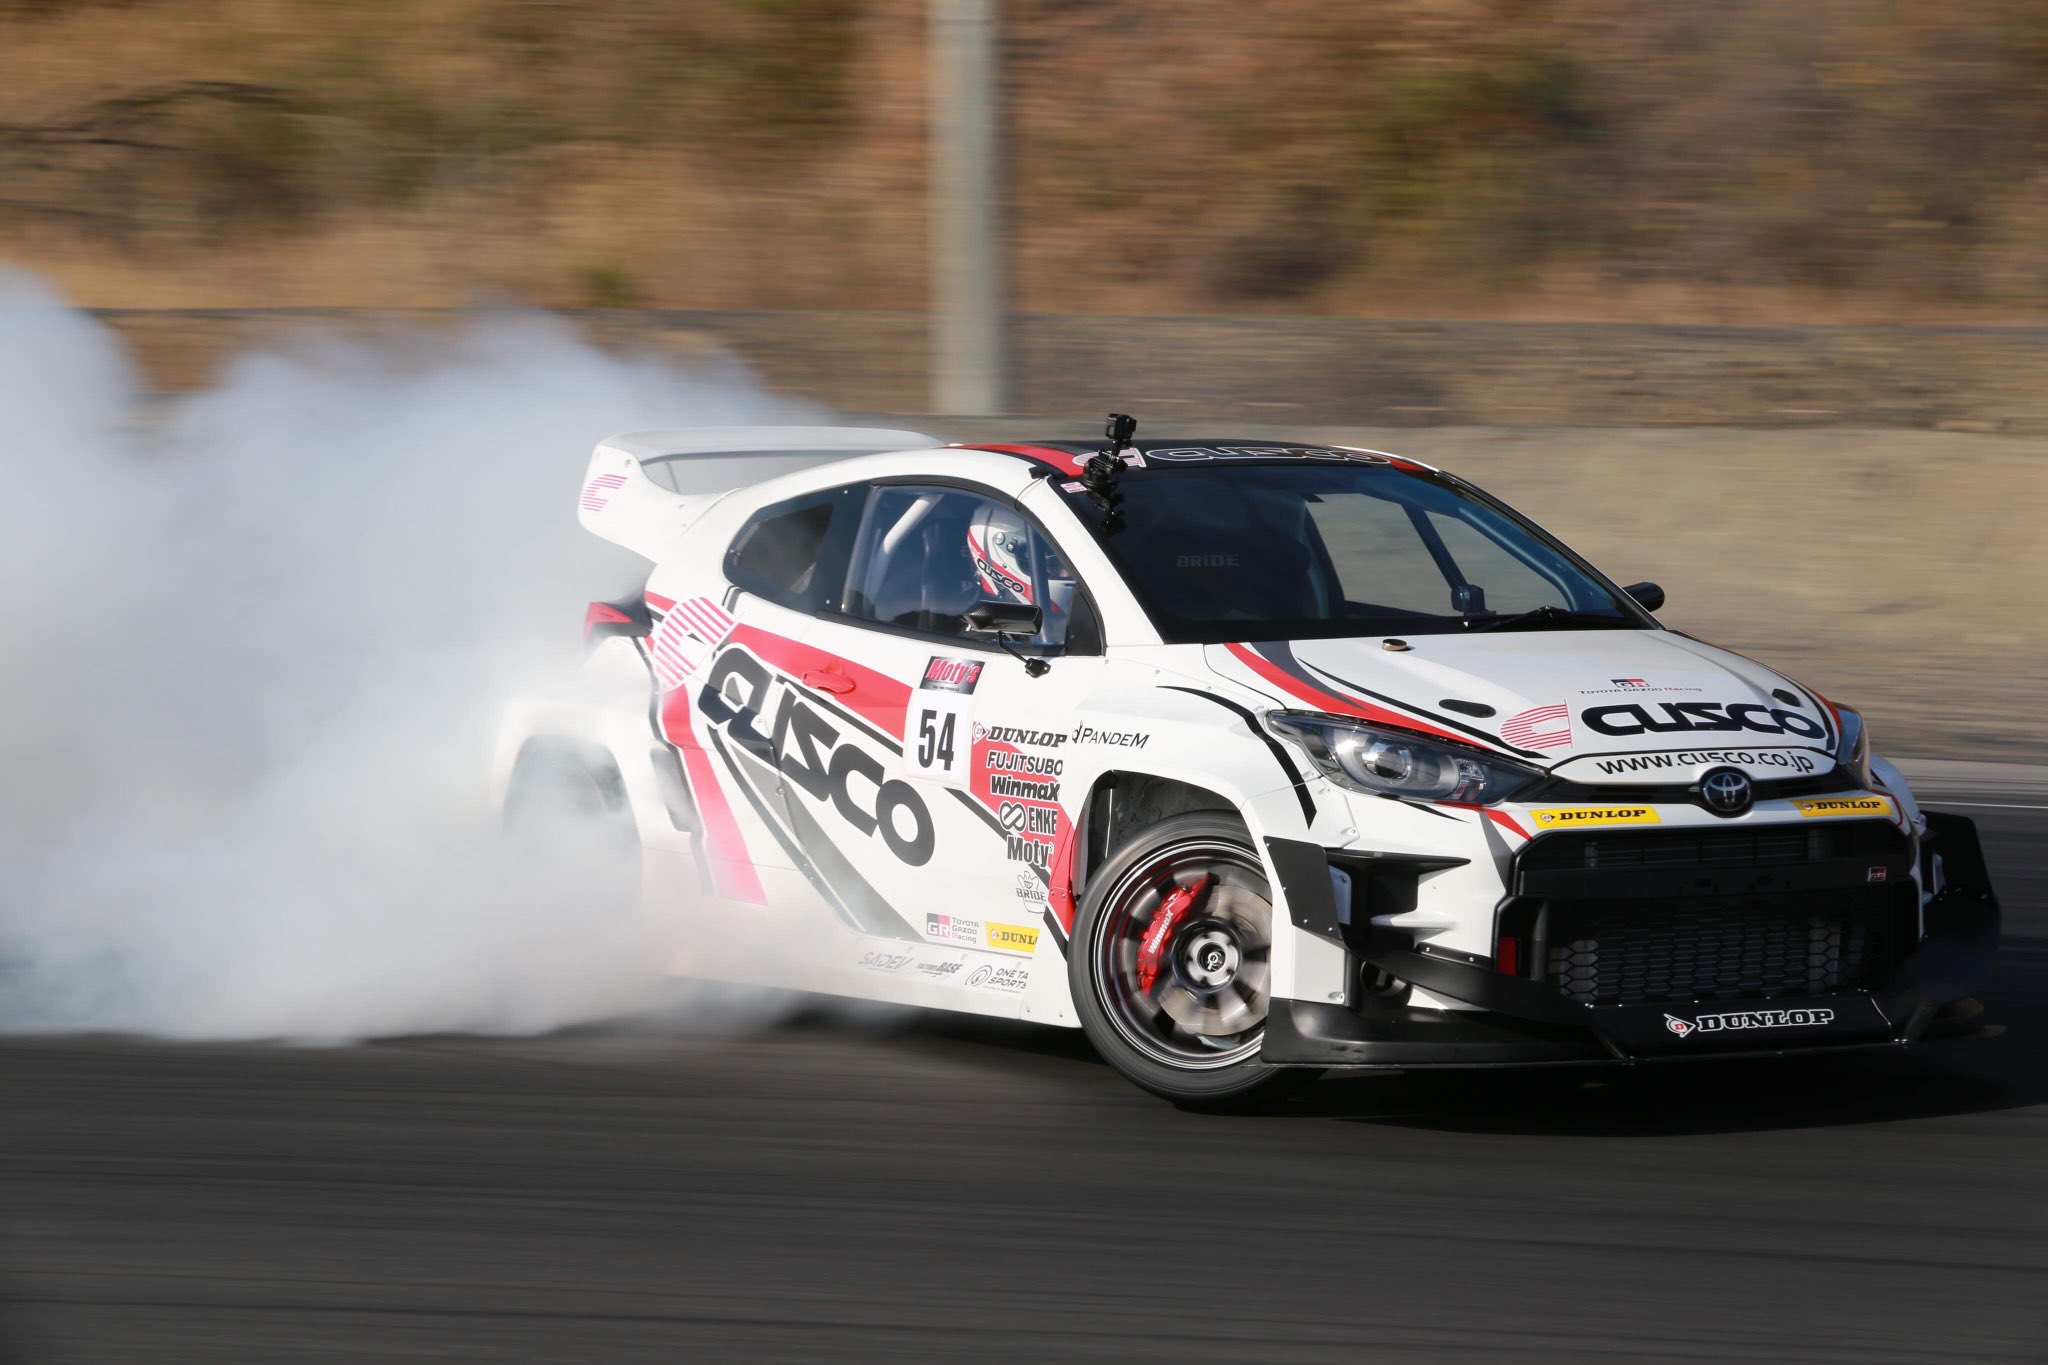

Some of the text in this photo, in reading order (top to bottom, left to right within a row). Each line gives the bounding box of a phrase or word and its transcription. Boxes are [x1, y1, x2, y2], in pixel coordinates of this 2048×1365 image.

[1176, 553, 1240, 568] BRIDE
[926, 658, 981, 685] Moty's
[918, 709, 956, 771] 54
[988, 725, 1067, 748] DUNLOP
[987, 751, 1063, 776] FUJITSUBO
[1596, 750, 1814, 774] www.cusco.co.jp
[1814, 800, 1881, 812] DUNLOP
[1559, 808, 1647, 821] DUNLOP
[1016, 888, 1046, 901] BRIDE
[952, 917, 979, 928] TOYOTA
[952, 925, 977, 935] GAZOO
[952, 932, 977, 944] Racing
[996, 968, 1017, 978] ONE
[1697, 1009, 1834, 1031] DUNLOP
